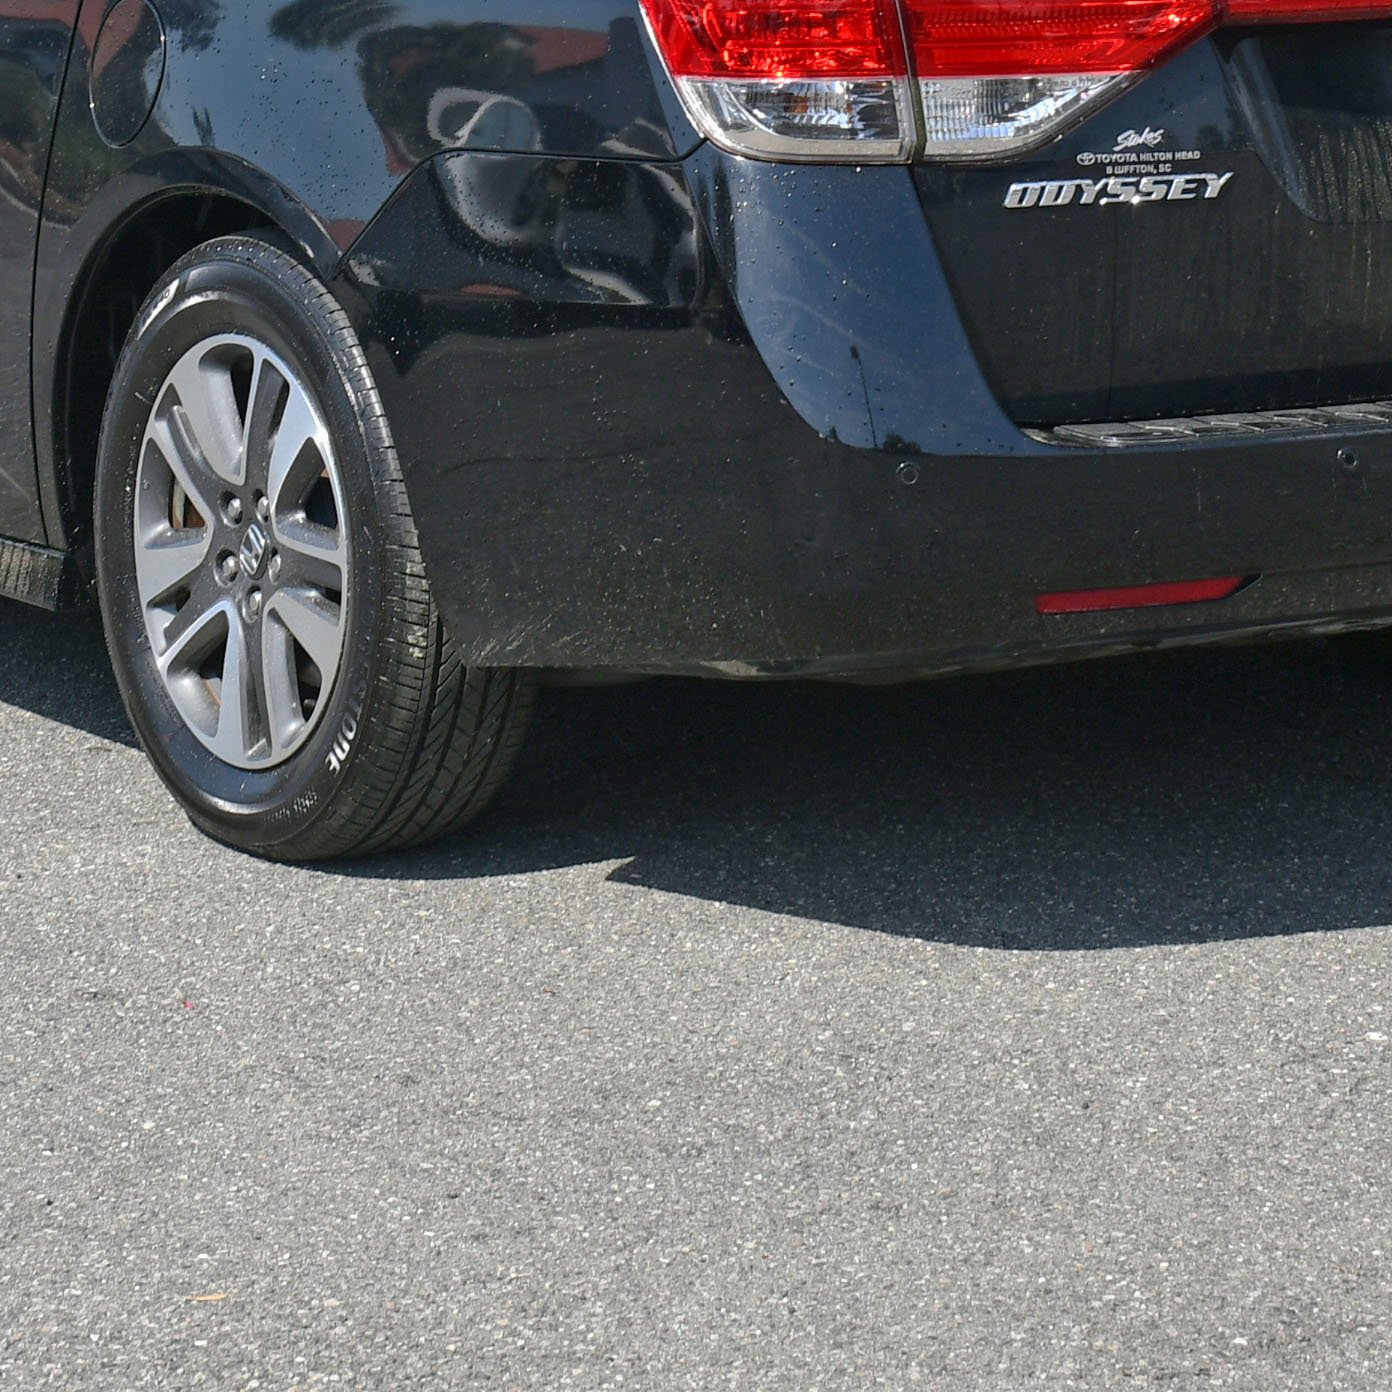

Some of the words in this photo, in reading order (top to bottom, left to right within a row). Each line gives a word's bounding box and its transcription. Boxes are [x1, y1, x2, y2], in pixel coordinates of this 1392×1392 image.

[1112, 127, 1164, 151] Stokes
[1095, 153, 1138, 163] TOYOTA
[1139, 151, 1173, 162] HILTON
[1174, 150, 1201, 161] HEAD
[1158, 163, 1172, 173] SC
[1003, 171, 1234, 208] ODYSSEY
